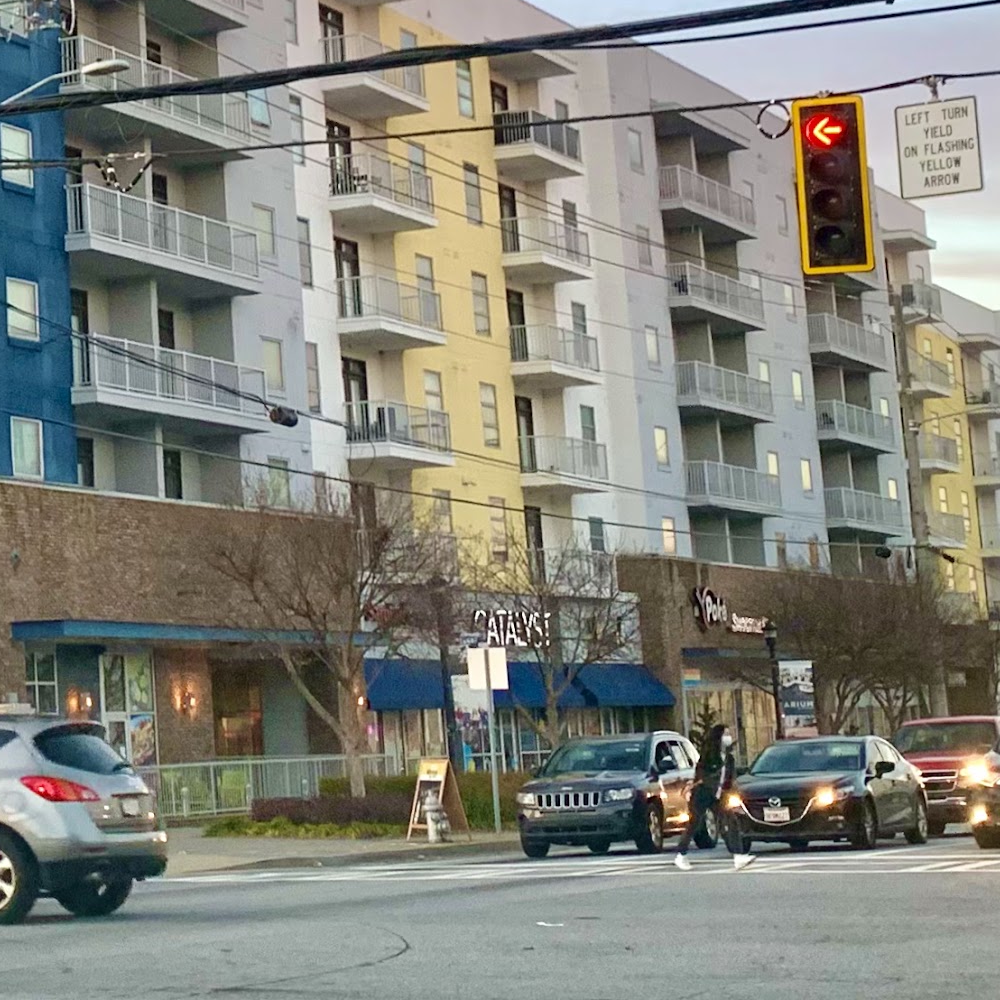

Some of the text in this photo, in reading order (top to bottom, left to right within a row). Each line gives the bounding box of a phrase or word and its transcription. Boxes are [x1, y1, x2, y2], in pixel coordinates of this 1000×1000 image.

[905, 106, 968, 126] LEFT TURN
[923, 125, 953, 139] YIELD
[904, 138, 975, 158] ON FLASHING
[920, 156, 961, 172] YELLOW
[924, 172, 960, 188] ARROW
